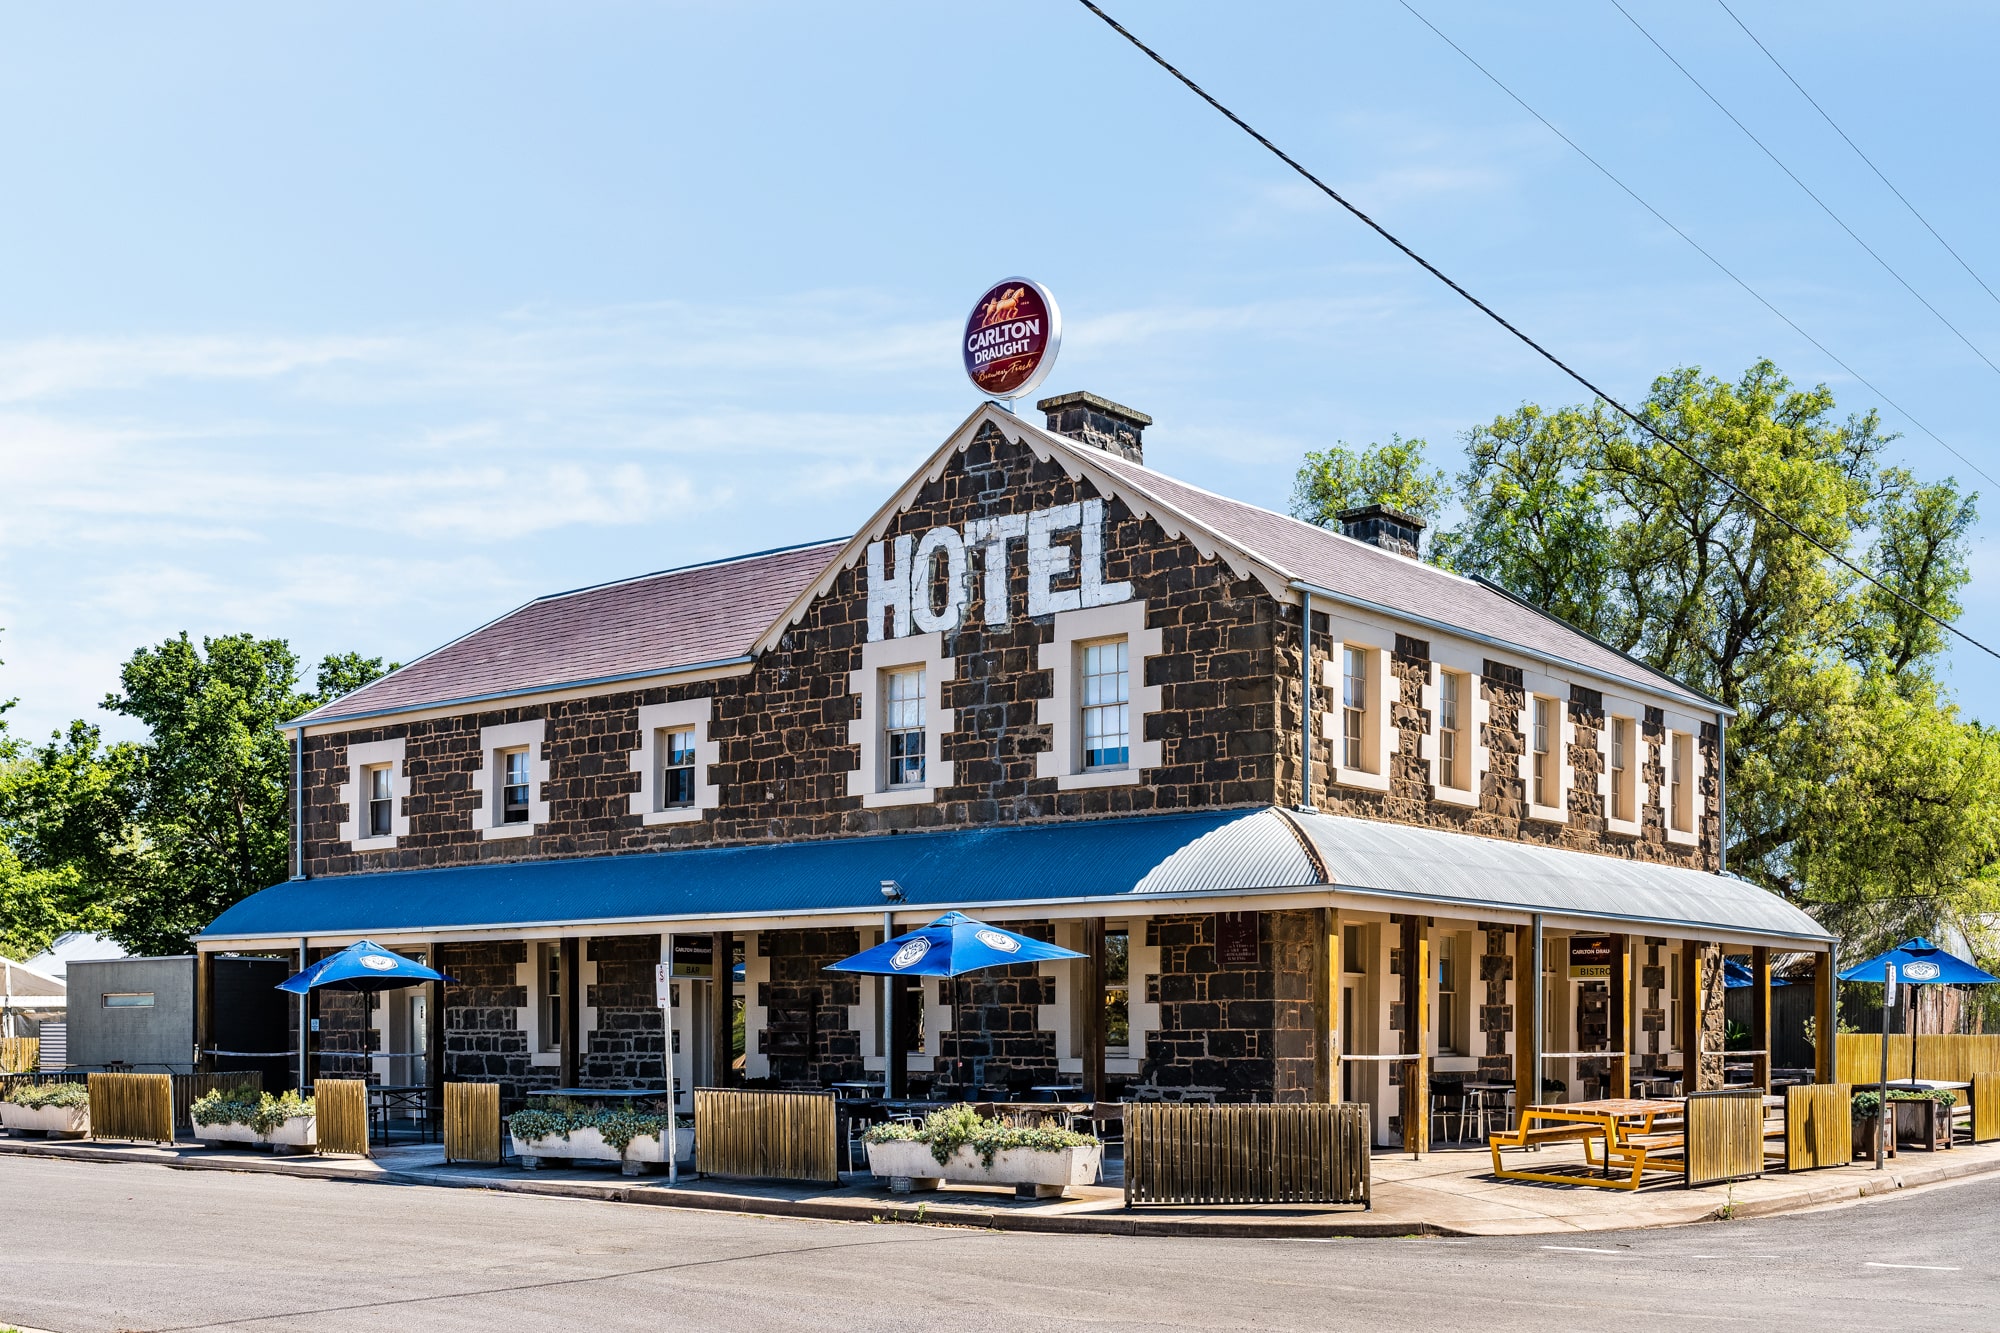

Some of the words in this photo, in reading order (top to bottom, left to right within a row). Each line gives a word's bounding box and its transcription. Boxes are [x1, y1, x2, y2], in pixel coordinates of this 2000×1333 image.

[967, 318, 1040, 352] CARLTON
[974, 339, 1030, 365] DRAUGHT
[866, 498, 1136, 643] HOTEL
